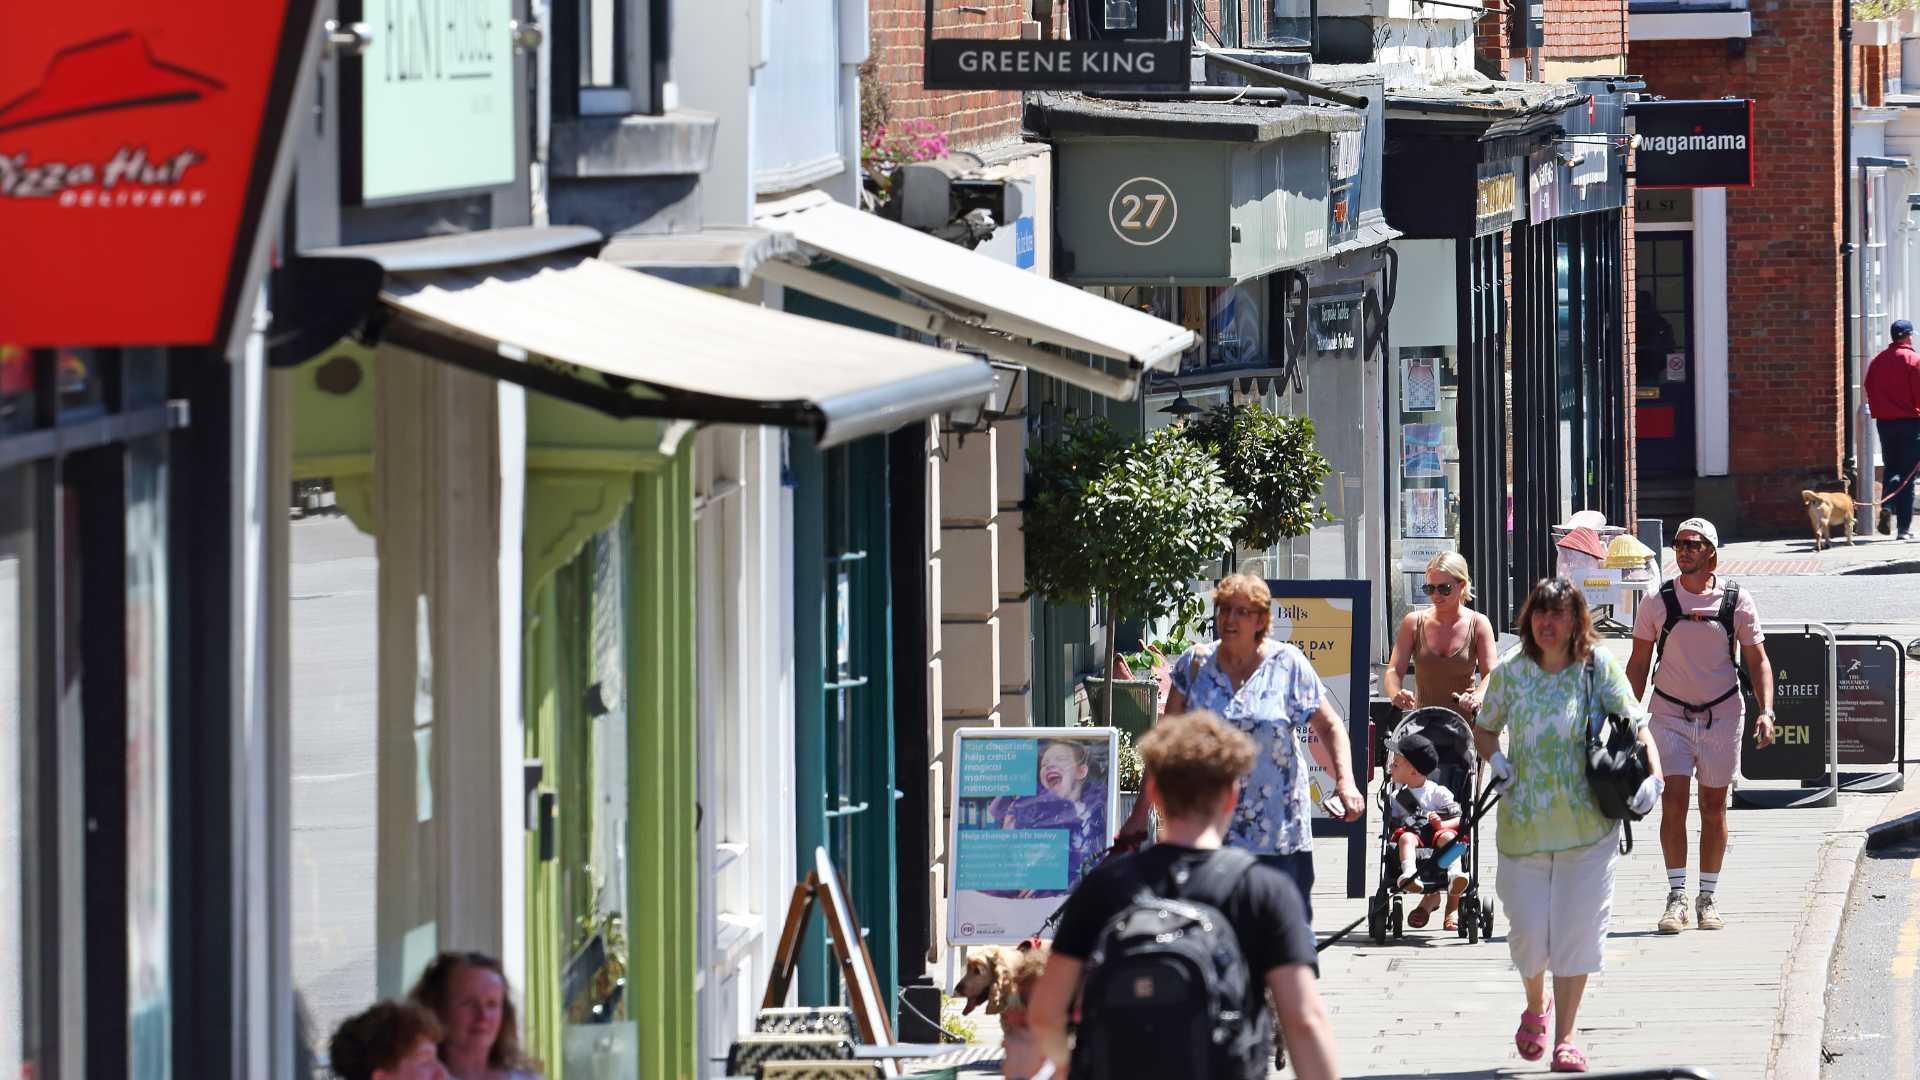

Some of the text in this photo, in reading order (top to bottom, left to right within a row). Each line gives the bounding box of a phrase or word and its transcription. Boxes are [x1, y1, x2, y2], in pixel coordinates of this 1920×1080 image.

[958, 50, 1156, 73] GREENE KING
[1640, 134, 1747, 155] wagamama
[101, 145, 208, 190] Hut
[59, 190, 206, 208] DELIVERY
[1120, 193, 1167, 231] 27
[1278, 605, 1309, 621] Bill's
[1310, 640, 1335, 650] DAY
[1777, 684, 1820, 697] STREET
[1297, 735, 1319, 744] GER
[1755, 725, 1810, 745] PEN
[964, 752, 1017, 762] help create
[964, 763, 1002, 773] magical
[963, 774, 1009, 782] moments
[963, 784, 1010, 792] memories
[961, 831, 980, 842] Help
[981, 831, 1011, 841] change
[1034, 831, 1057, 841] today
